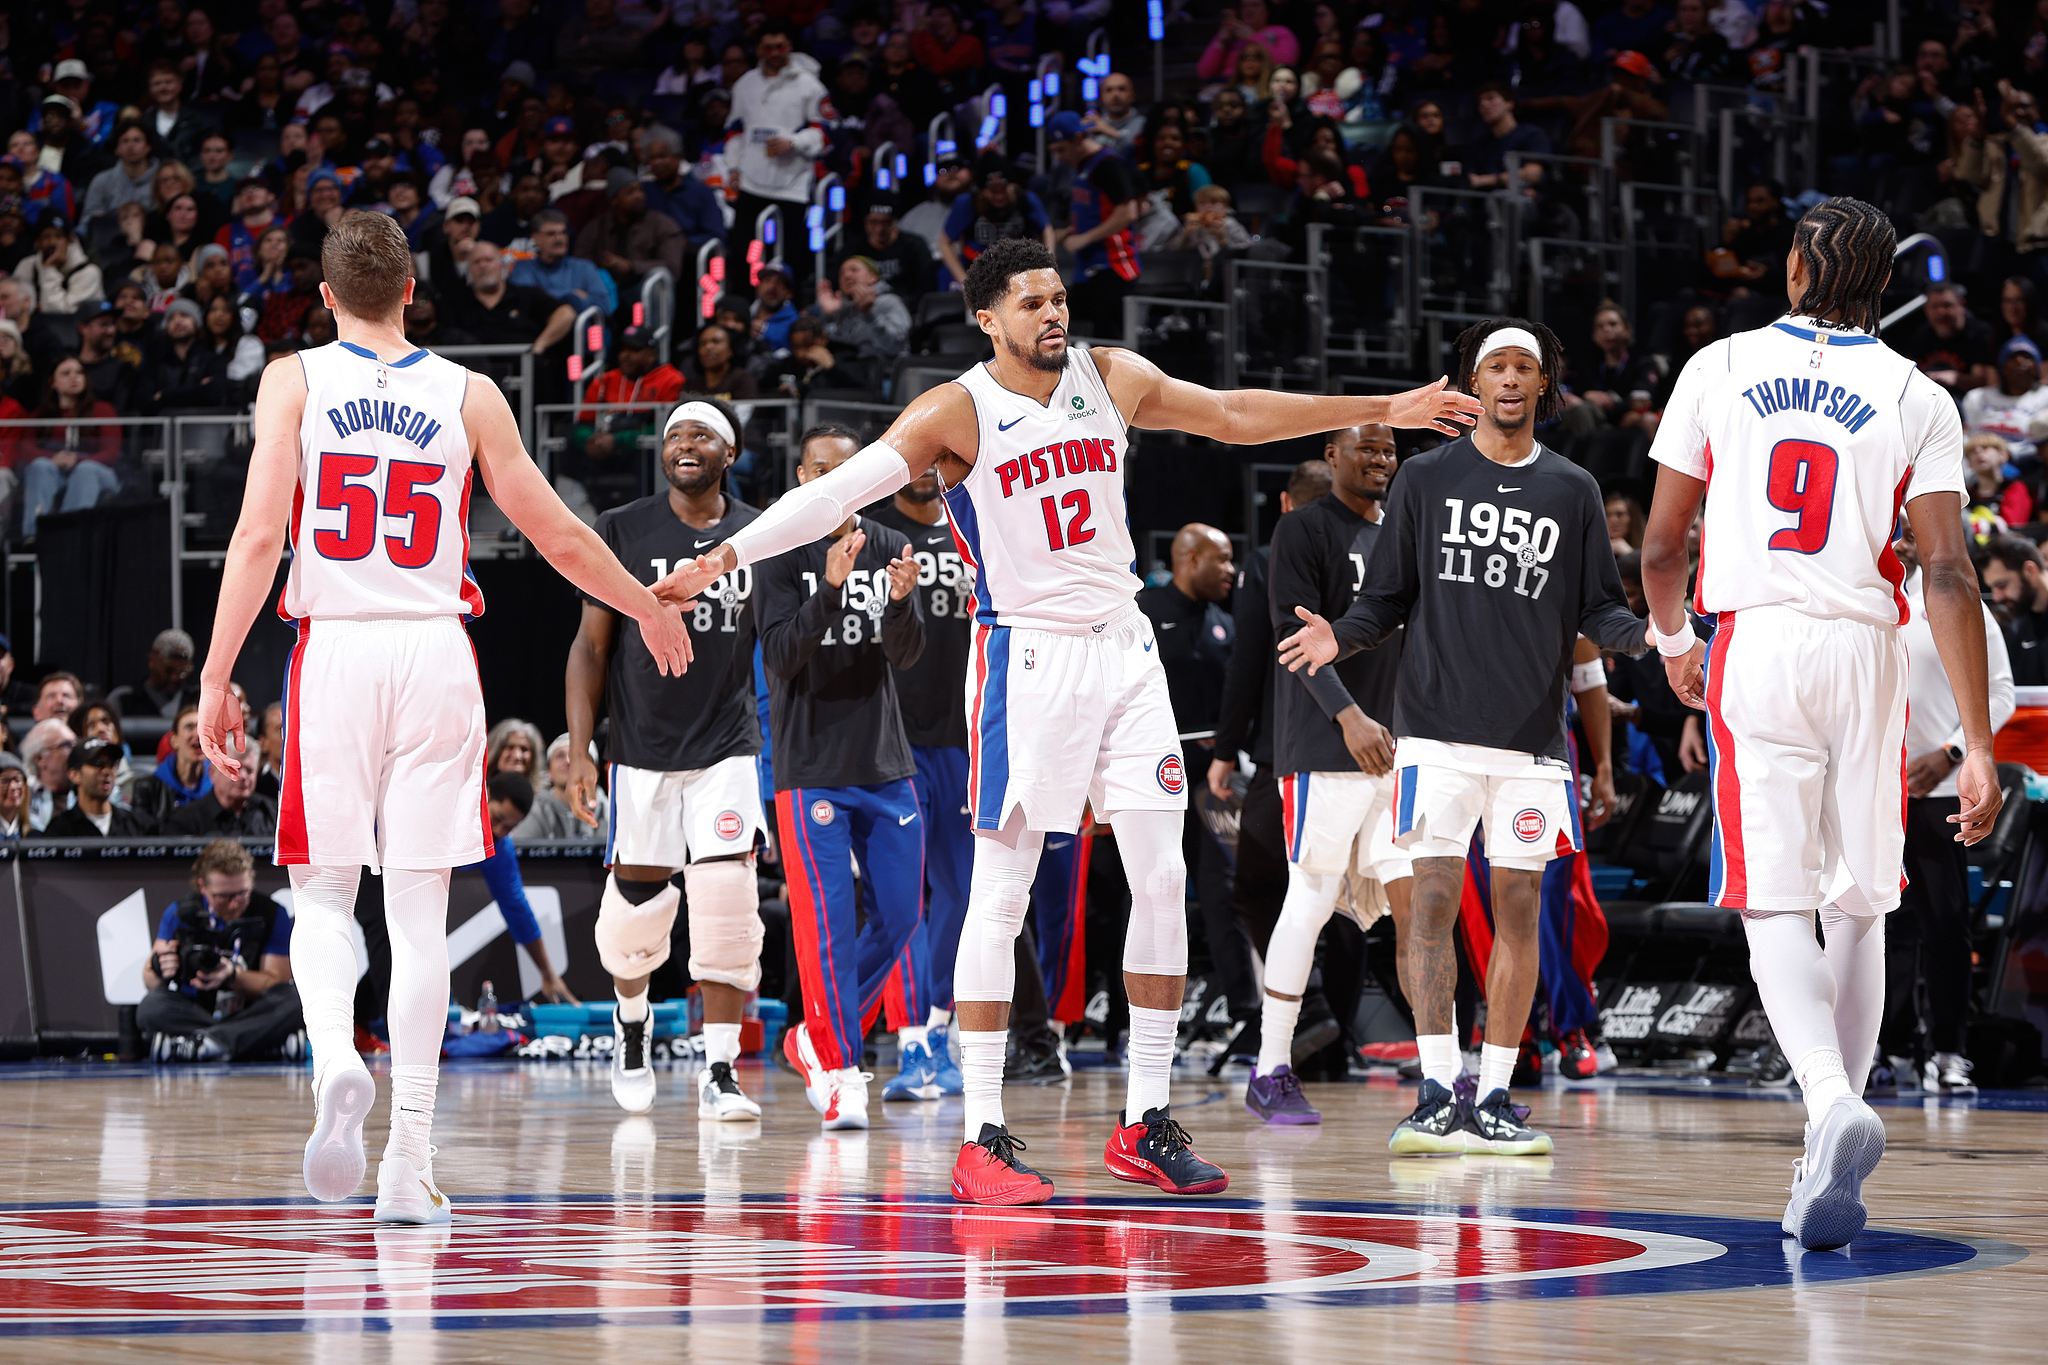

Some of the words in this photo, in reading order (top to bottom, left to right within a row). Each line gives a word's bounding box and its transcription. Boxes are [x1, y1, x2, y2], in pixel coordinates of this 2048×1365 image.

[327, 398, 441, 450] ROBINSON
[1067, 408, 1098, 421] StockX
[1742, 378, 1877, 434] THOMPSON
[995, 438, 1116, 498] PISTONS
[313, 451, 446, 569] 55
[1041, 489, 1096, 551] 12
[1767, 438, 1839, 555] 9
[1442, 498, 1560, 563] 1950
[1438, 546, 1475, 583] 11
[1483, 553, 1508, 588] 8
[1513, 561, 1549, 600] 17
[693, 601, 713, 632] 8
[842, 614, 863, 645] 8
[931, 589, 949, 617] 8
